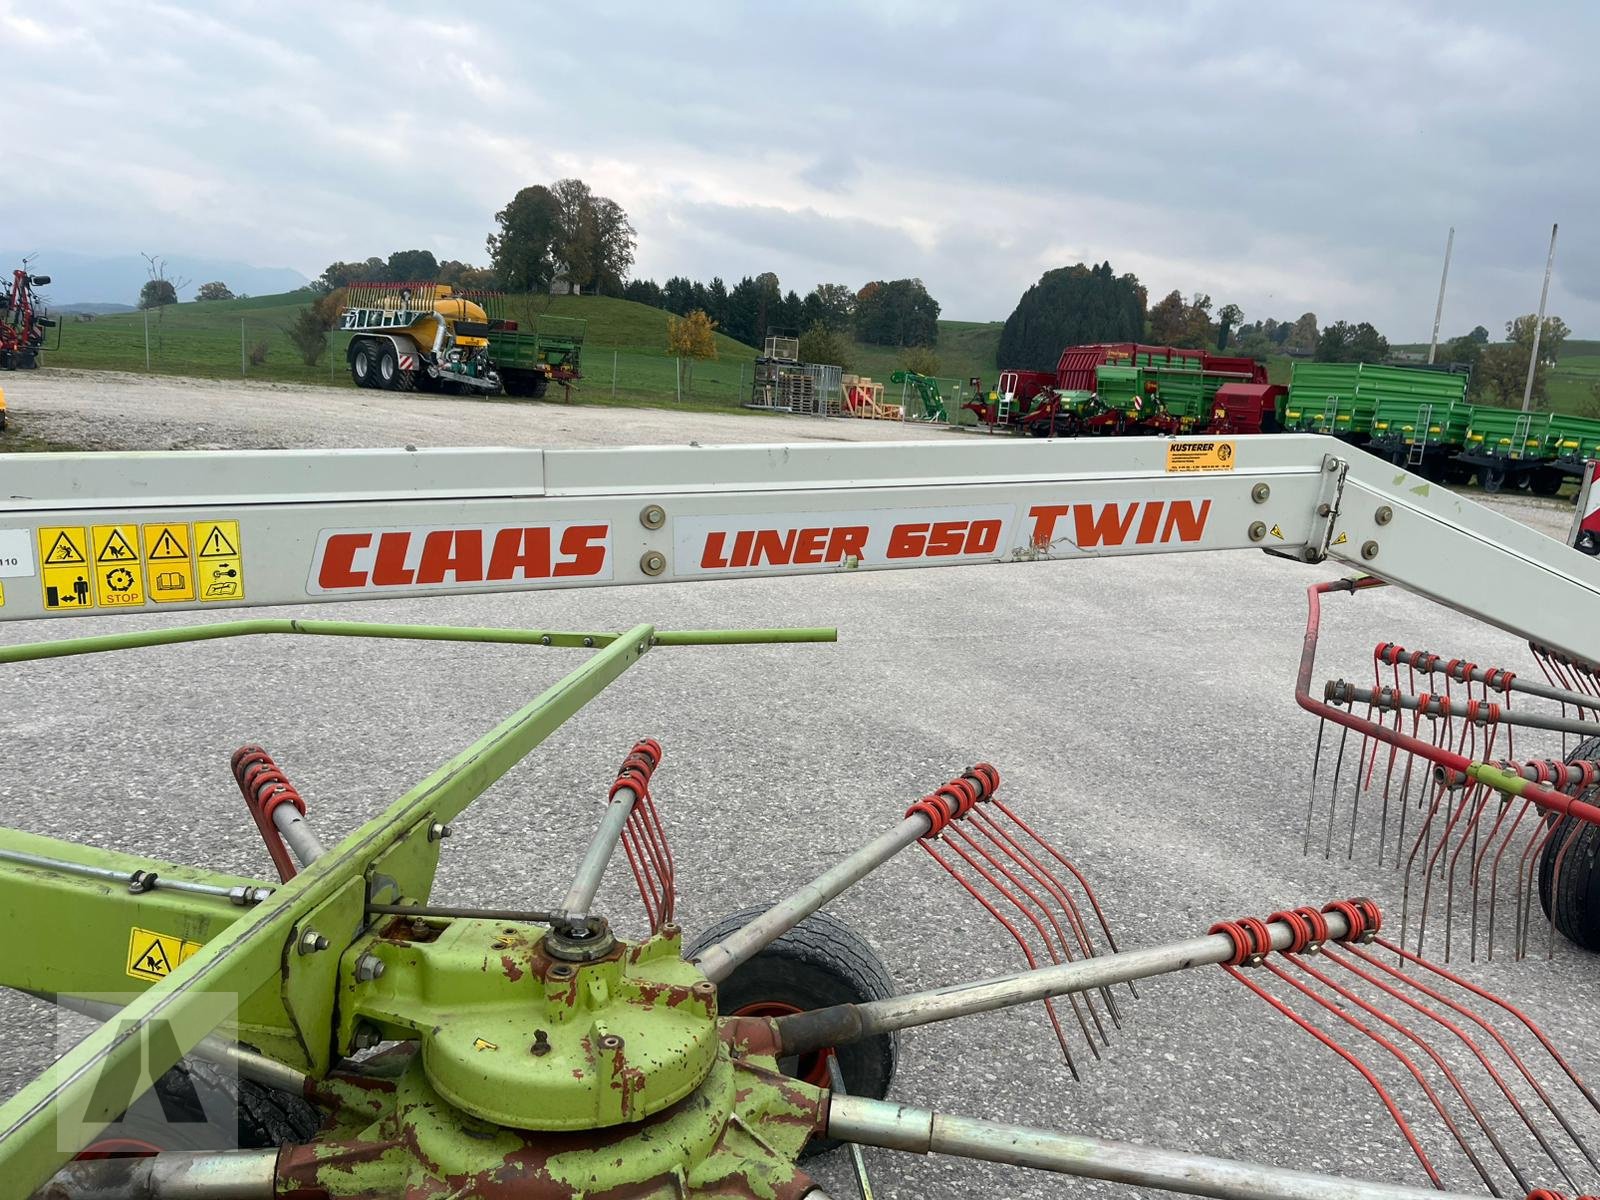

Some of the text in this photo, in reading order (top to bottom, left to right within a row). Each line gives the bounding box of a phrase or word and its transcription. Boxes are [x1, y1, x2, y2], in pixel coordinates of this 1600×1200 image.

[319, 525, 608, 588] CLAAS
[701, 500, 1211, 569] LINER 650 TWIN
[106, 593, 139, 604] STOP
